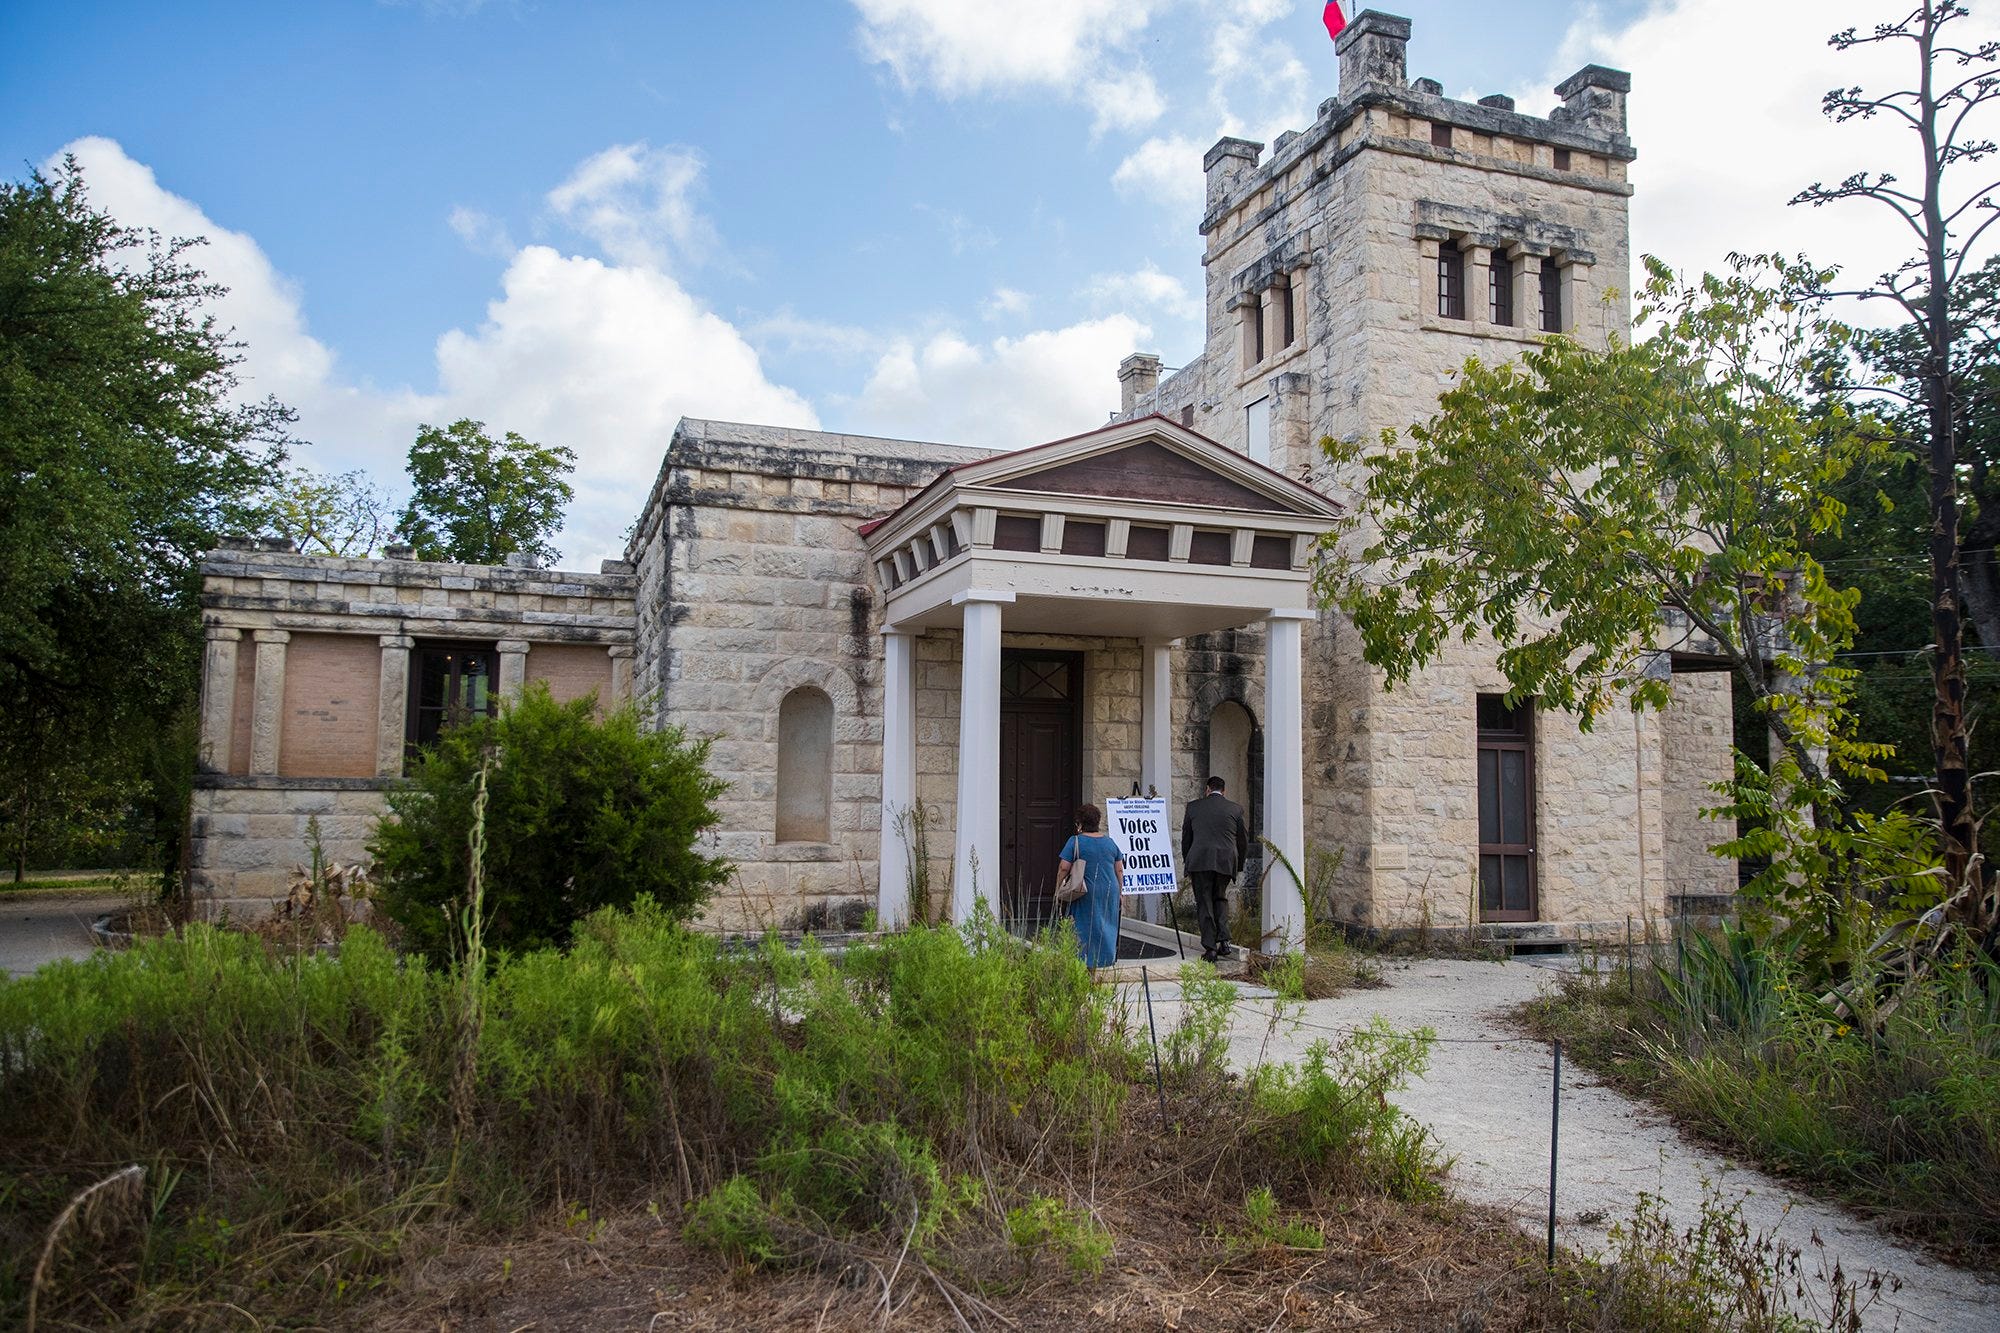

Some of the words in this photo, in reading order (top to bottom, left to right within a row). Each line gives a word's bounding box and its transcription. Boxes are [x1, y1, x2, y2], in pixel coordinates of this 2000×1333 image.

[1119, 818, 1157, 834] Votes
[1129, 835, 1150, 851] for
[1123, 875, 1133, 886] EY
[1137, 874, 1173, 885] MUSEUM
